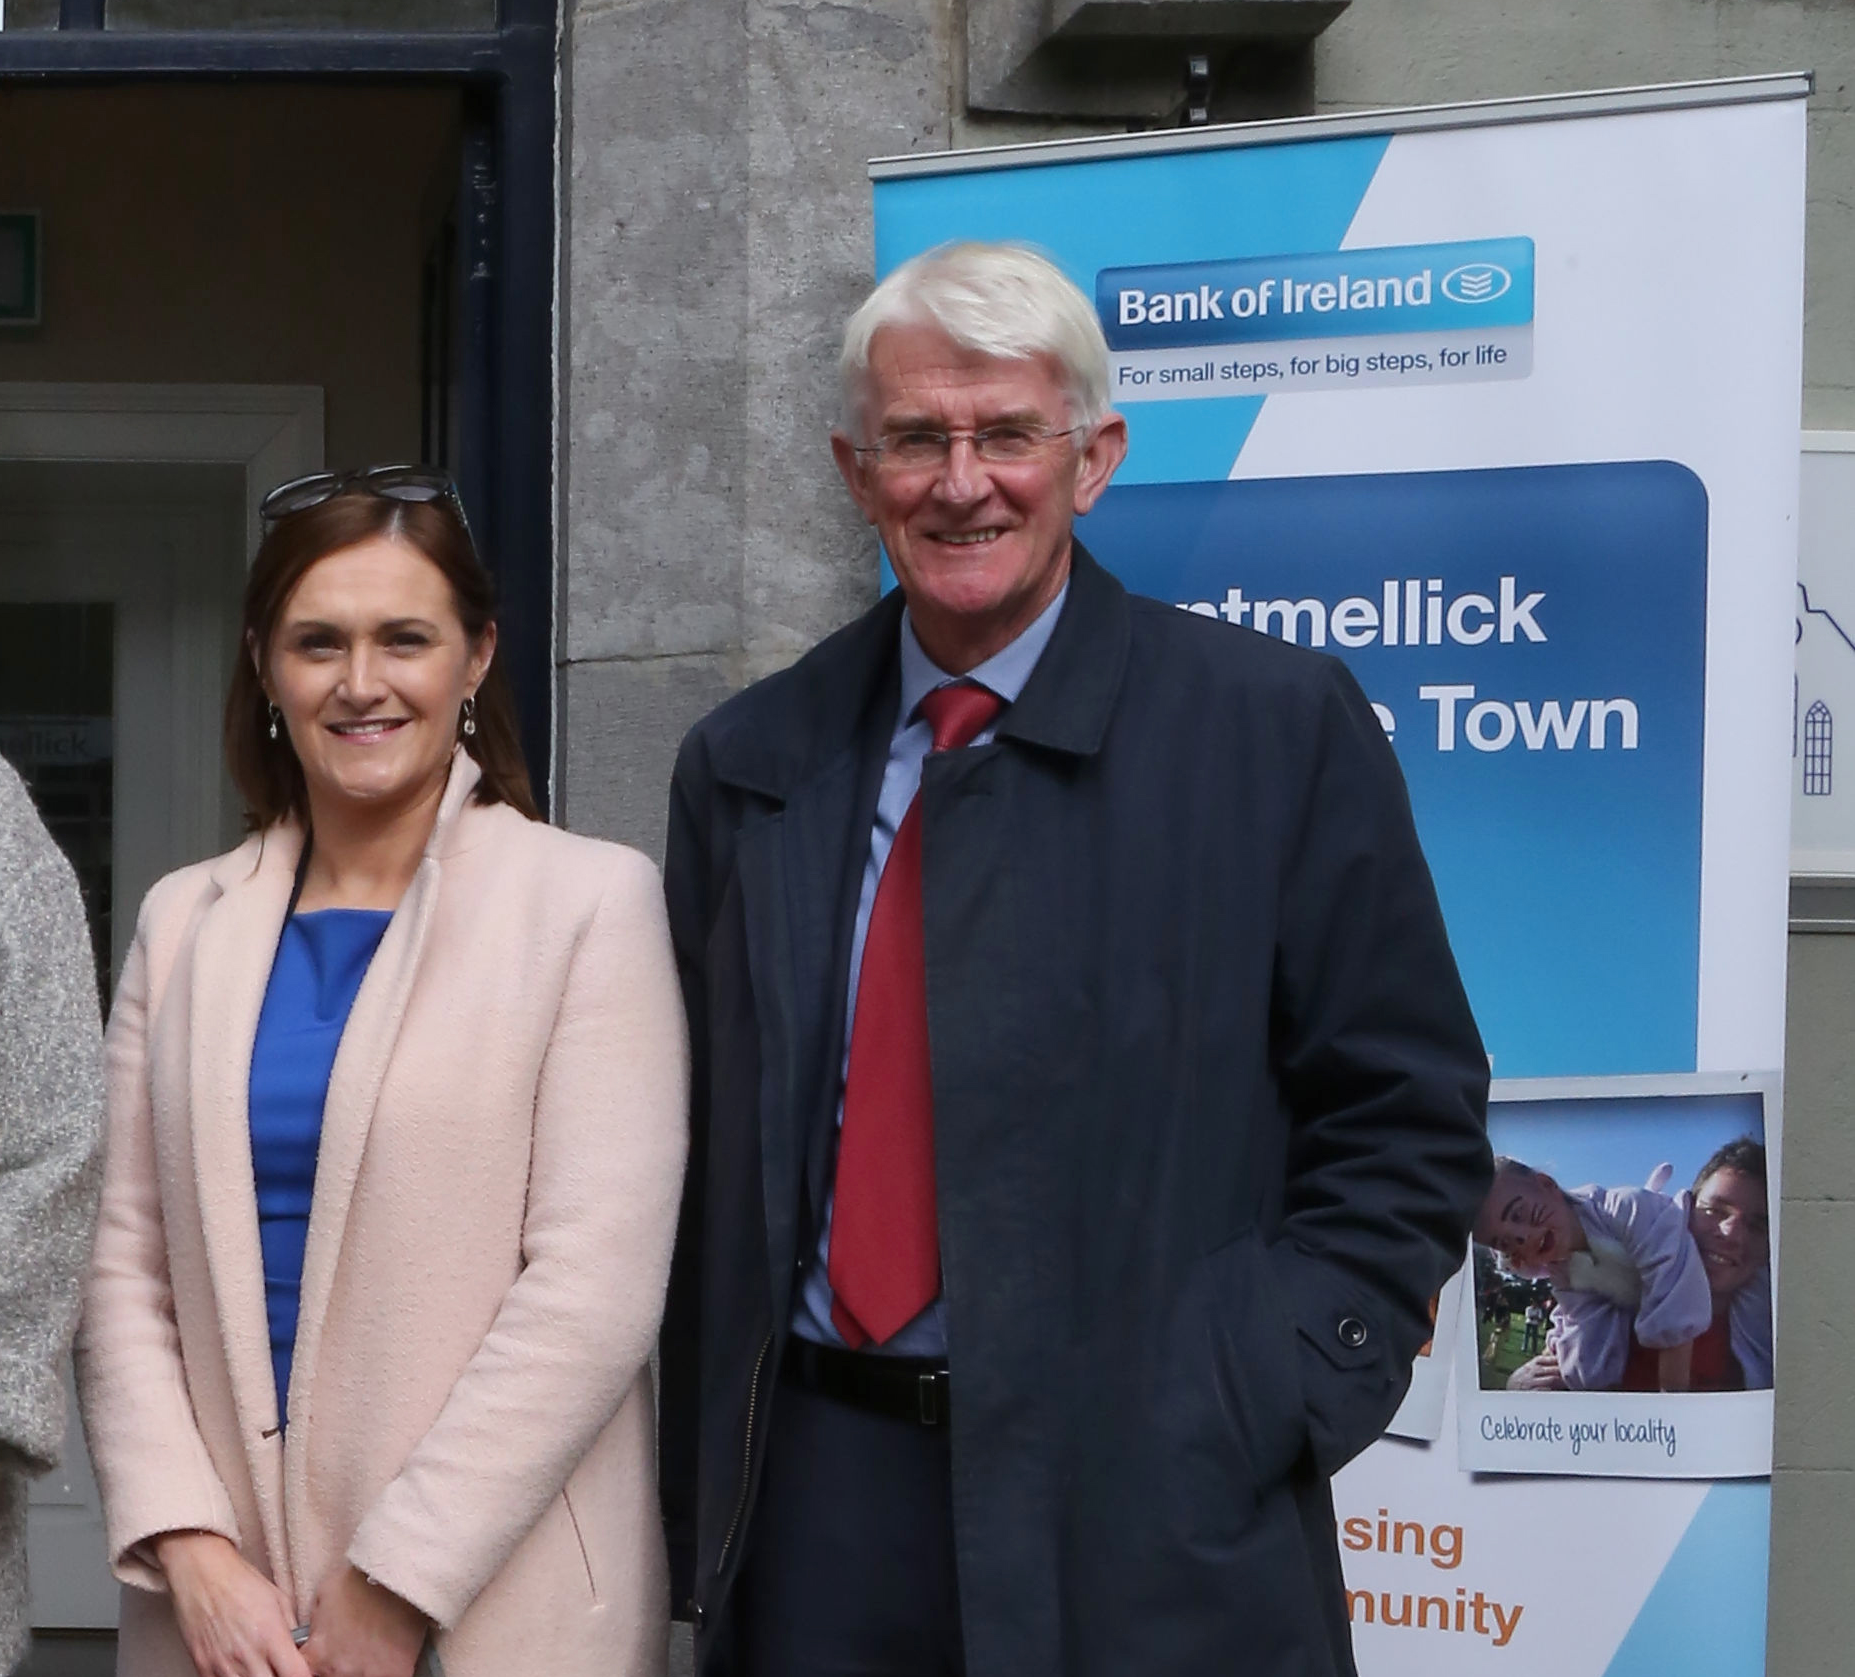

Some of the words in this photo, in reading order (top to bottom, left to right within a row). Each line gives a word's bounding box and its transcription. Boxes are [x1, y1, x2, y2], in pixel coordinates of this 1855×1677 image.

[1118, 285, 1225, 326] Bank
[1230, 279, 1276, 318] of
[1282, 269, 1432, 314] Ireland
[1118, 366, 1154, 386] For
[1159, 361, 1214, 383] small
[1219, 360, 1284, 382] steps,
[1289, 356, 1320, 376] for
[1326, 354, 1360, 378] big
[1366, 351, 1433, 373] steps,
[1438, 347, 1470, 367] for
[1475, 344, 1508, 365] life
[1418, 684, 1640, 752] Town
[1480, 1414, 1564, 1443] Celebrate
[1569, 1420, 1609, 1456] your
[1614, 1417, 1677, 1458] locality
